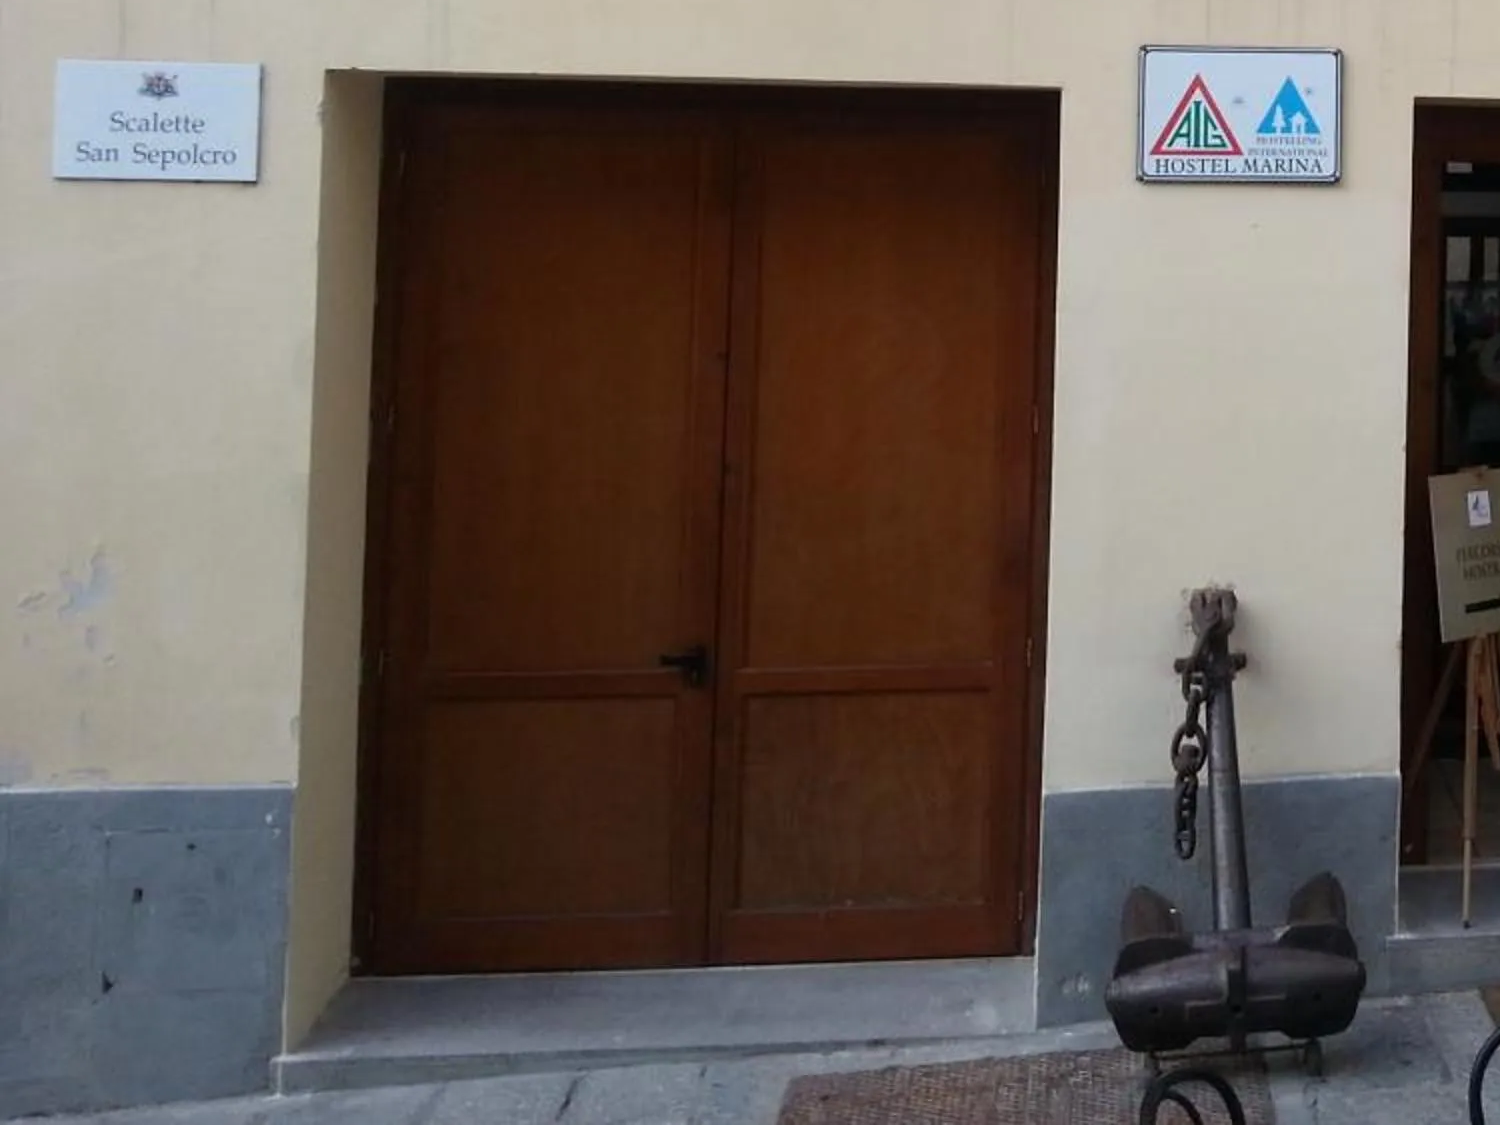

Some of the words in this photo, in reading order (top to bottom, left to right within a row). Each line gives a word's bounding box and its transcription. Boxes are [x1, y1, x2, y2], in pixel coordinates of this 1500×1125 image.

[109, 110, 206, 134] Scalette
[75, 141, 119, 163] San
[132, 142, 237, 171] Sepolcro
[1155, 158, 1236, 173] HOSTEL
[1242, 159, 1323, 174] MARINA
